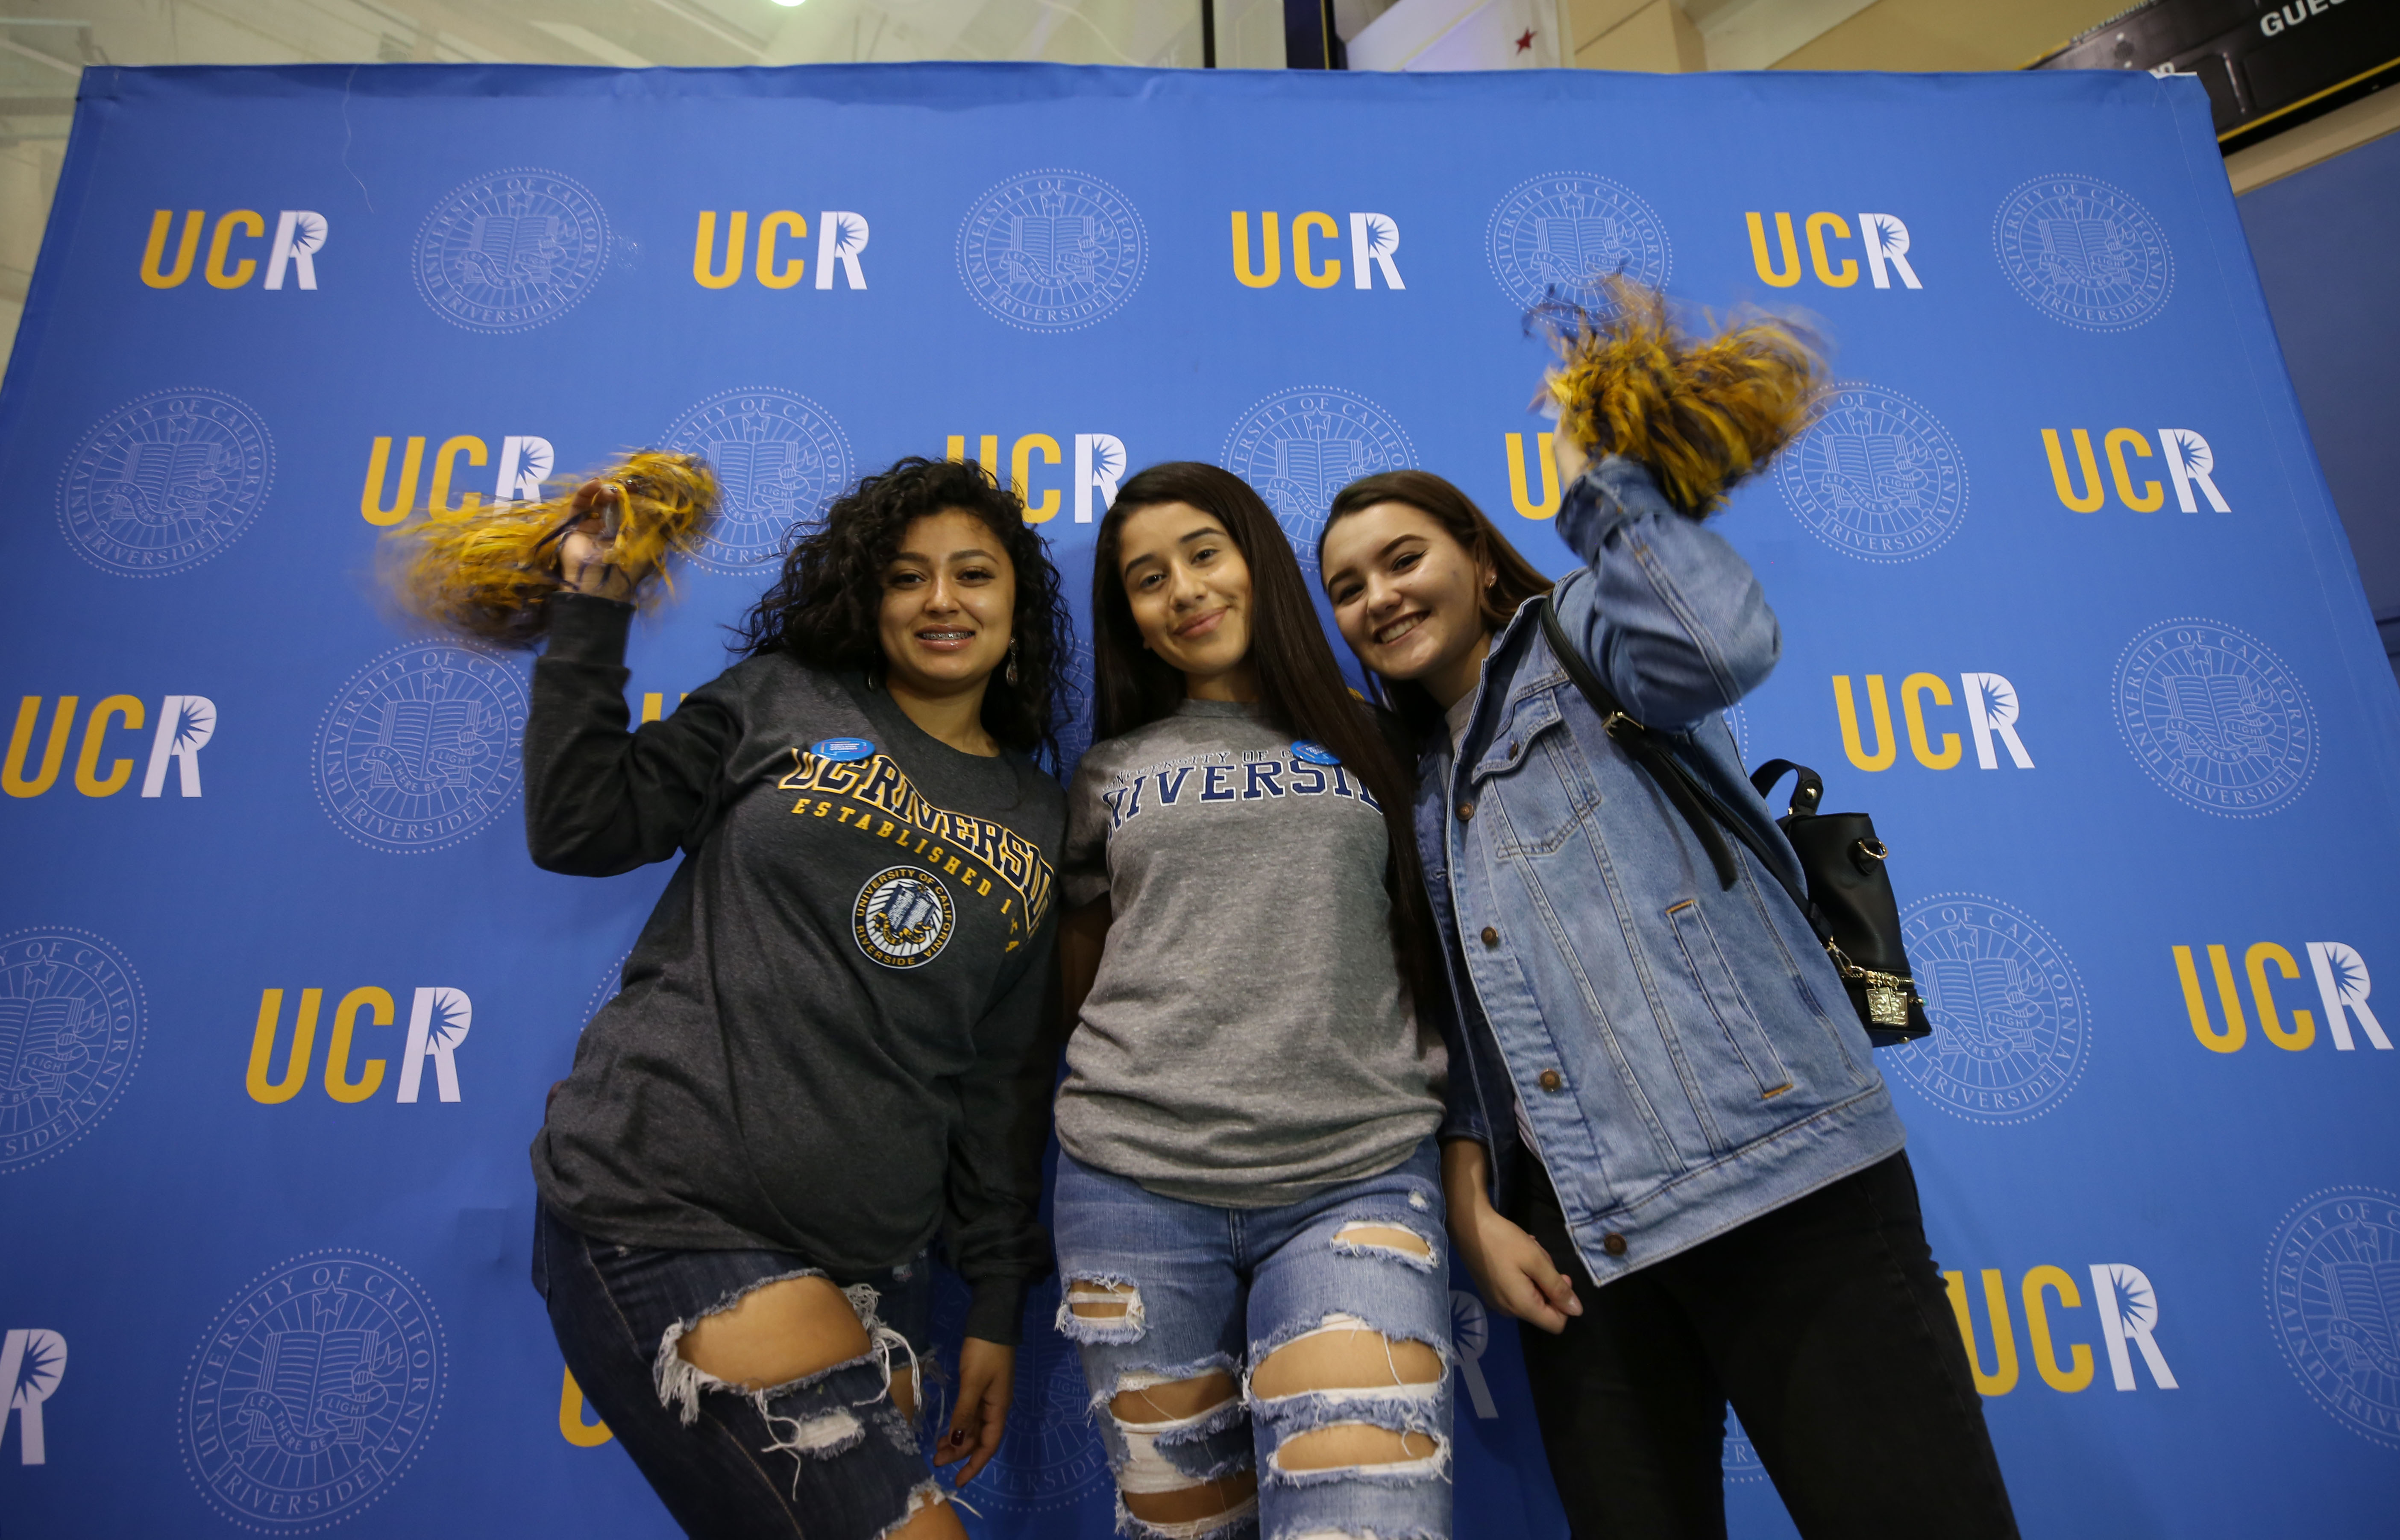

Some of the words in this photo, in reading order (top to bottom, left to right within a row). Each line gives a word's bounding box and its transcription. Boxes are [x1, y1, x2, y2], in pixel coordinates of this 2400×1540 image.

[507, 179, 536, 190] OF
[141, 211, 327, 290] UCR
[693, 210, 869, 290] UCR
[969, 184, 1025, 288] UNIVERSITY
[1038, 179, 1066, 191] OF
[1078, 184, 1136, 289] CALIFORNIA
[1232, 211, 1405, 289] UCR
[1498, 187, 1545, 288] UNIVERSITY
[1555, 182, 1581, 192] OF
[1746, 212, 1922, 289] UCR
[2005, 189, 2044, 288] UNIVERSITY
[2053, 184, 2078, 194] OF
[2091, 189, 2162, 290] CALIFORNIA
[999, 296, 1105, 322] RIVERSIDE
[2051, 296, 2147, 321] RIVERSIDE
[740, 398, 771, 411] OF
[1300, 397, 1330, 409] OF
[72, 406, 153, 525] UNIVERSITY
[168, 399, 202, 413] OF
[211, 405, 261, 526] CALIFORNIA
[361, 435, 554, 526] UCR
[1840, 394, 1867, 406] OF
[1881, 399, 1956, 515] CALIFORNIA
[1885, 477, 1915, 488] LIGHT
[2041, 428, 2231, 512] UCR
[762, 486, 794, 498] LIGHT
[1273, 480, 1293, 490] LET
[1295, 491, 1320, 518] THERE
[92, 535, 210, 565] RIVERSIDE
[1831, 523, 1936, 550] RIVERSIDE
[328, 659, 407, 795] UNIVERSITY
[422, 652, 456, 666] OF
[468, 659, 525, 796] CALIFORNIA
[1832, 672, 2035, 772] UCR
[2126, 637, 2168, 764] UNIVERSITY
[2177, 630, 2206, 642] OF
[2221, 636, 2305, 763] CALIFORNIA
[3, 695, 216, 797] UCR
[372, 750, 393, 758] LET
[397, 761, 417, 791] THERE
[424, 782, 437, 792] BE
[438, 752, 472, 764] LIGHT
[1242, 750, 1268, 763] OF
[2171, 721, 2190, 731] LET
[2194, 732, 2225, 760] THERE
[2231, 723, 2262, 735] LIGHT
[2181, 773, 2289, 804] RIVERSIDE
[352, 807, 476, 839] RIVERSIDE
[792, 799, 992, 896] ESTABLISHED
[856, 869, 915, 916] UNIVERSITY
[918, 873, 935, 884] OF
[856, 925, 915, 965] RIVERSIDE
[923, 887, 952, 957] CALIFORNIA
[1942, 907, 1973, 923] OF
[1989, 913, 2077, 1061] CALIFORNIA
[2172, 942, 2393, 1053] UCR
[25, 942, 63, 958] OF
[75, 949, 131, 1106] CALIFORNIA
[246, 987, 472, 1104] UCR
[1928, 1013, 1949, 1024] LET
[1954, 1024, 1986, 1057] THERE
[1995, 1014, 2030, 1028] LIGHT
[32, 1057, 69, 1071] LIGHT
[1934, 1072, 2055, 1108] RIVERSIDE
[13, 1090, 28, 1103] BE
[2280, 1212, 2326, 1381] UNIVERSITY
[2336, 1203, 2371, 1221] OF
[1943, 1264, 2179, 1395] UCR
[197, 1277, 293, 1458] UNIVERSITY
[312, 1267, 351, 1285] OF
[364, 1275, 429, 1453] CALIFORNIA
[249, 1396, 274, 1410] LET
[273, 1411, 302, 1451] THERE
[310, 1438, 327, 1451] BE
[328, 1399, 368, 1414] LIGHT
[224, 1470, 370, 1514] RIVERSIDE
